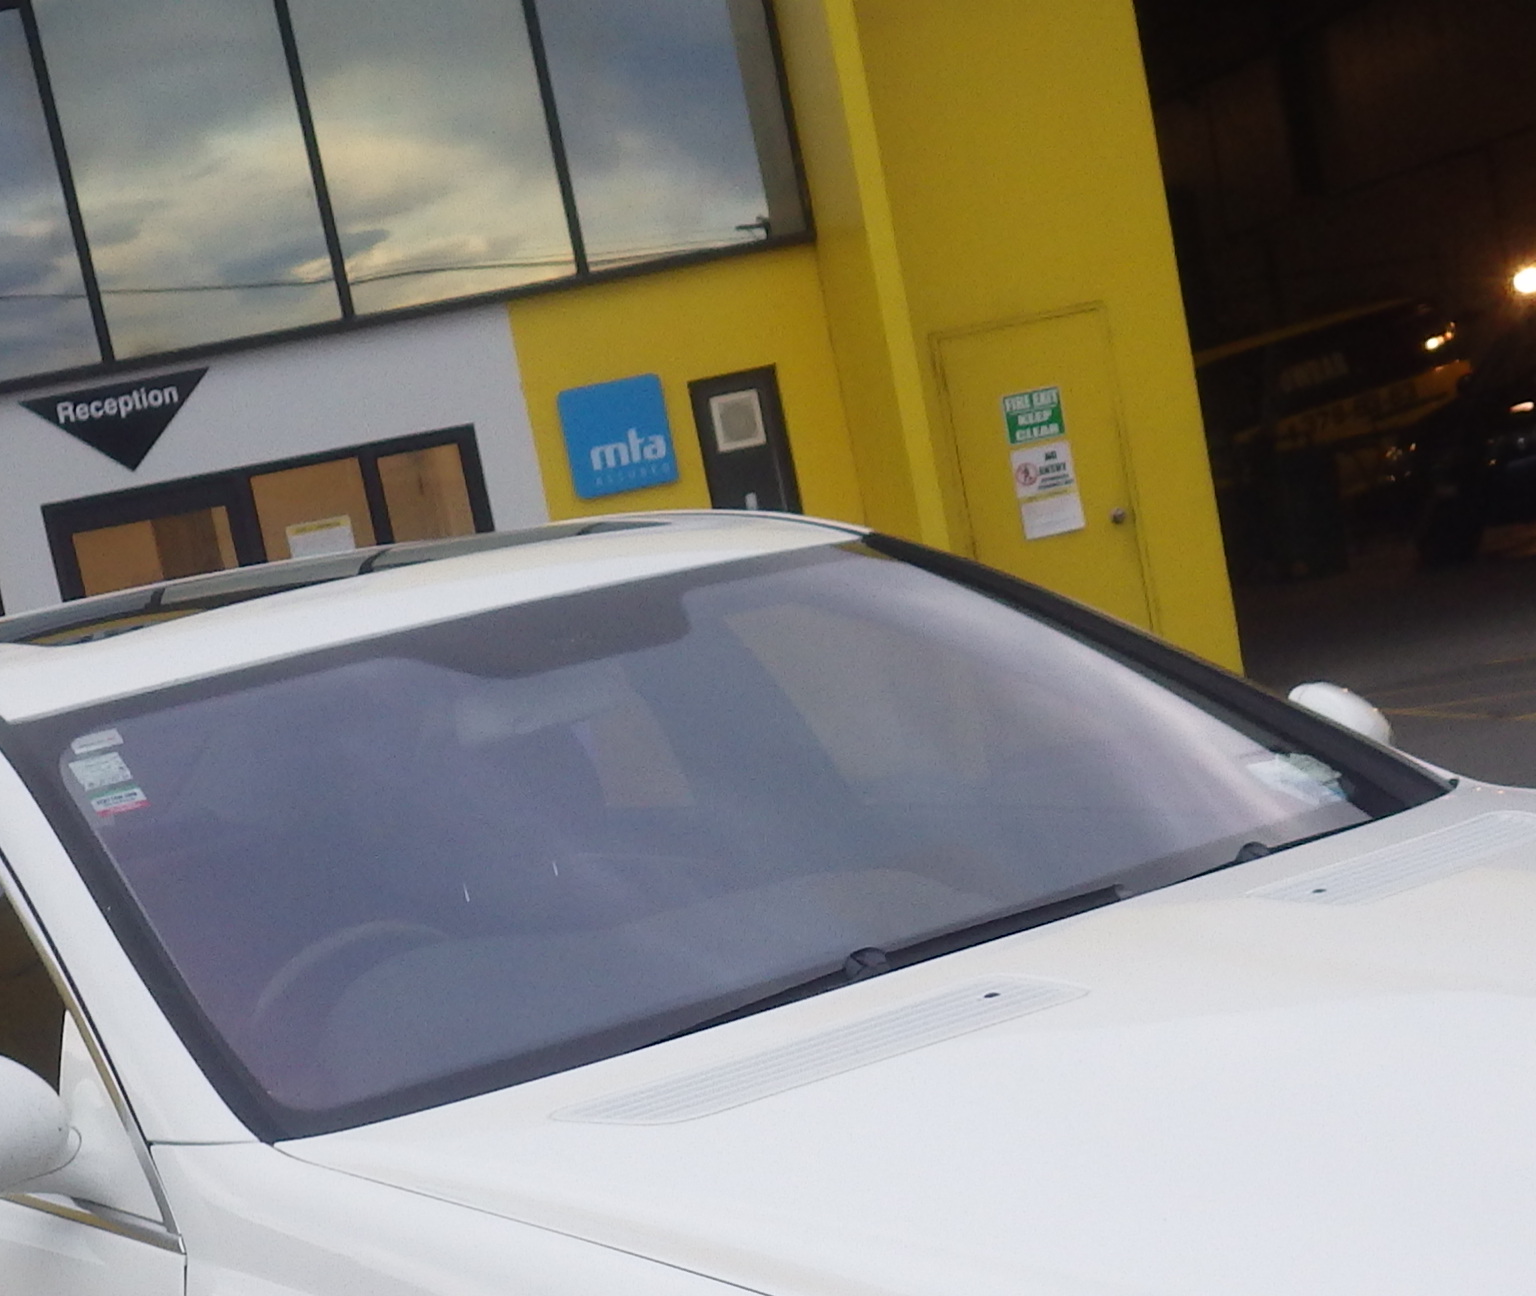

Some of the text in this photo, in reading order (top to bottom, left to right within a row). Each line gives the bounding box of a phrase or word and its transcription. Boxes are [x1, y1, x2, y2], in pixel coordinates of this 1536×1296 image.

[56, 386, 179, 424] Reception
[1005, 389, 1059, 412] FIRE EXIT
[1017, 409, 1052, 426] KEEP
[1015, 423, 1060, 441] CLEAR
[590, 427, 667, 471] mta
